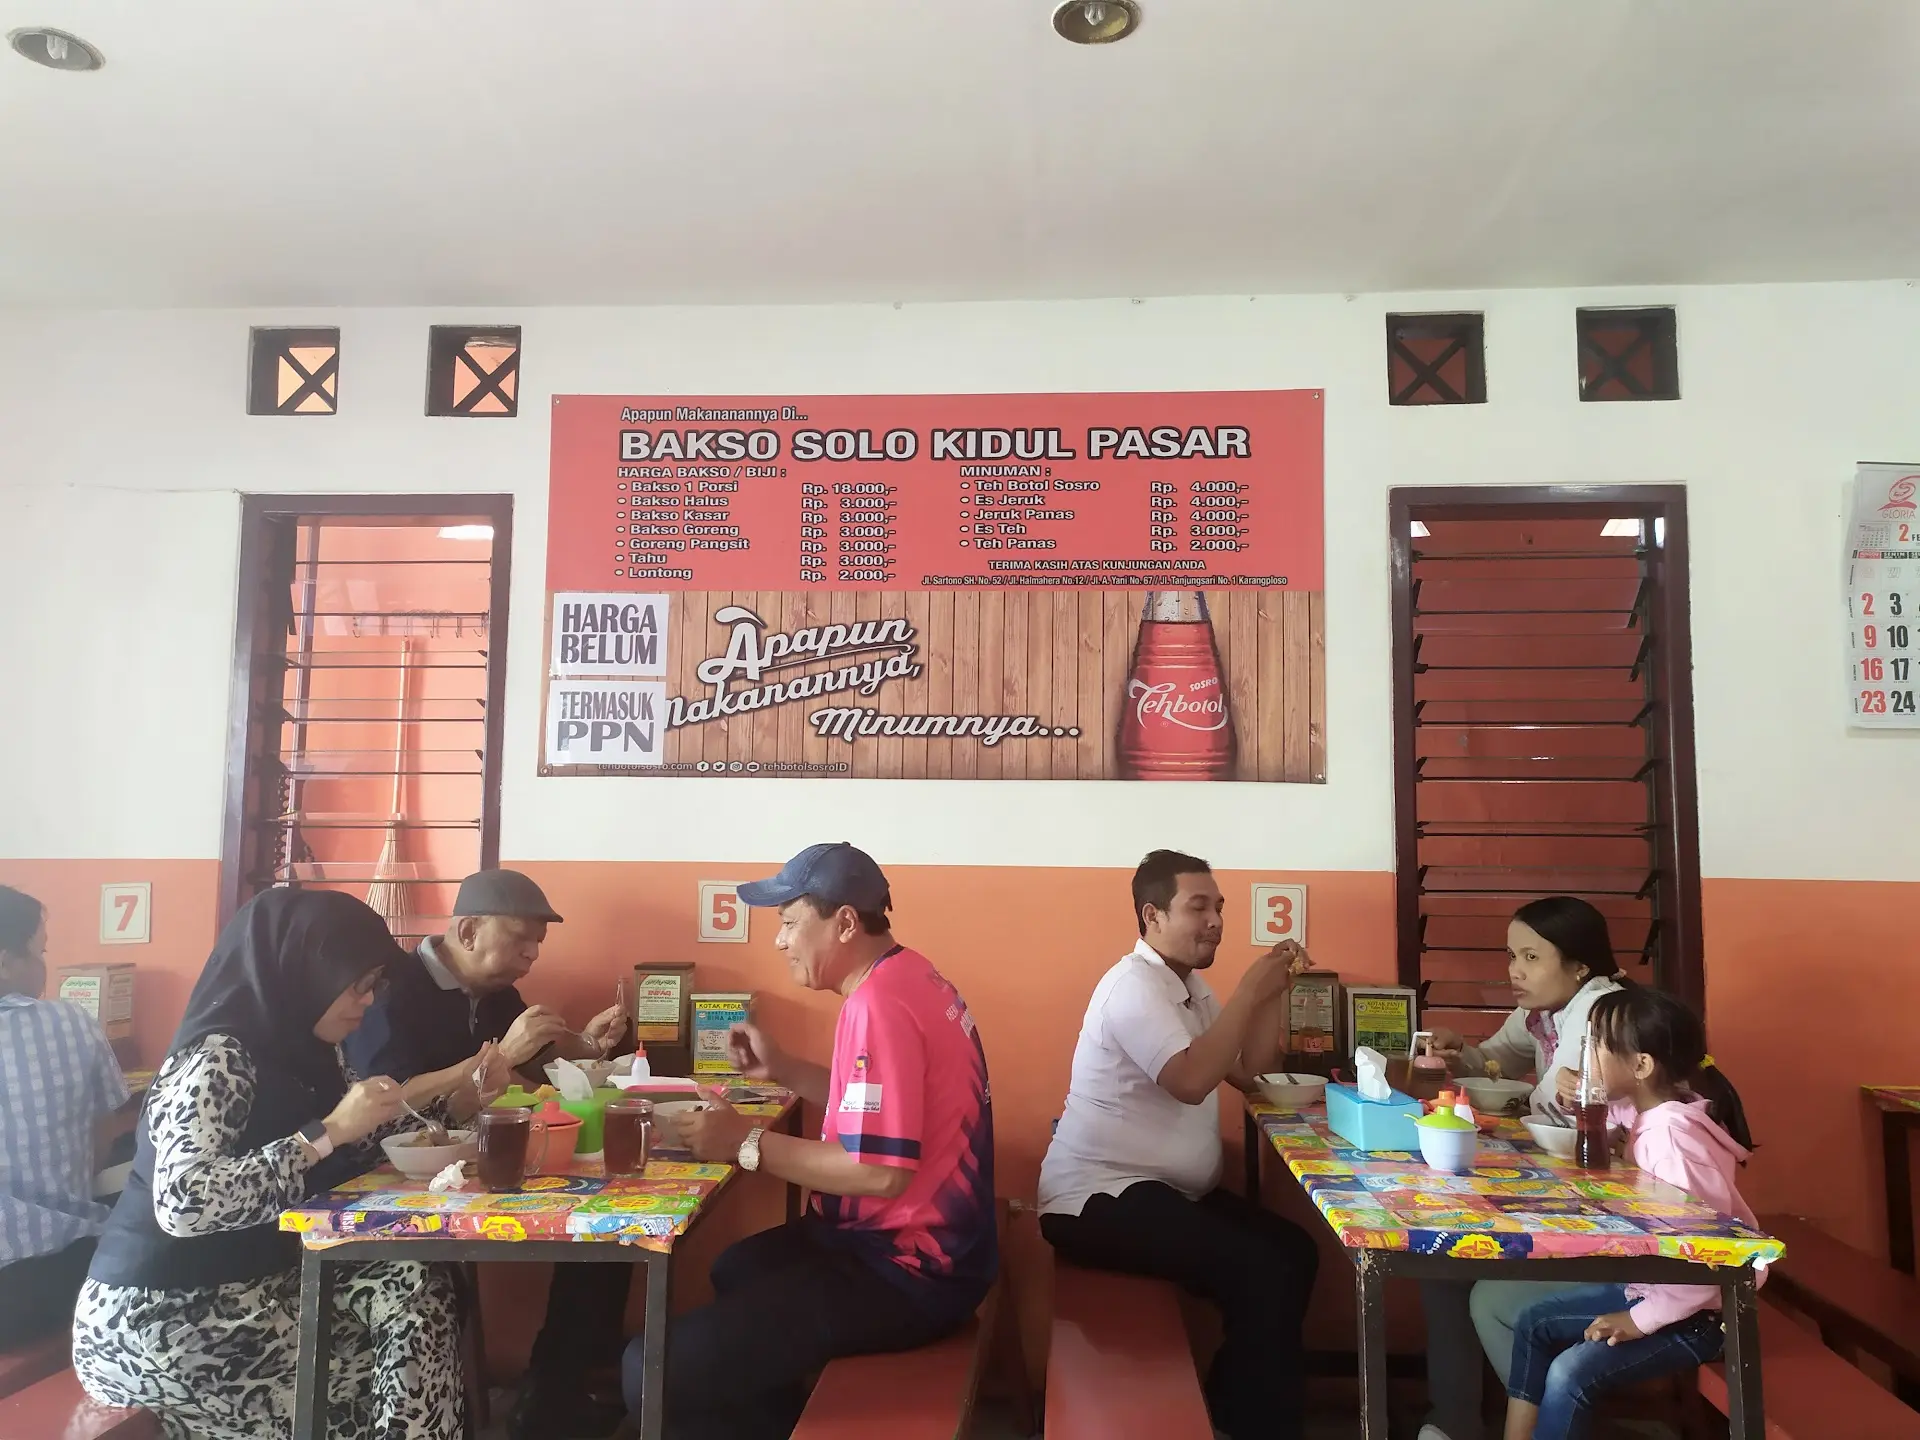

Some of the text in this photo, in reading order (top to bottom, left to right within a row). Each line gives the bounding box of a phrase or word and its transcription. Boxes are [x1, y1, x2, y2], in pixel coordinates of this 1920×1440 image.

[621, 406, 808, 422] Apapun Makananannya Di...
[619, 426, 1251, 462] BAKSO SOLO KIDUL PASAR
[618, 466, 672, 478] HARGA
[677, 466, 731, 478] BAKSO
[734, 466, 742, 478] /
[745, 466, 777, 478] BIJI
[960, 466, 1040, 477] MINUMAN
[631, 481, 897, 496] Bakso 1 Porsi Rp. 18.000,-
[975, 480, 1249, 494] Teh Botol Sosro Rp. 4.000,-
[631, 495, 897, 510] Bakso Halus Rp. 3.000,-
[975, 495, 1249, 509] Es Jeruk Rp. 4.000,-
[631, 510, 896, 524] Bakso Kasar Rp. 3.000,-
[974, 509, 1249, 523] Jeruk Panas Rp. 4.000,-
[1881, 509, 1916, 519] GLORIA
[630, 524, 896, 539] Bakso Goreng Rp. 3.000,-
[974, 523, 1249, 538] Es Teh Rp. 3.000,-
[1898, 523, 1910, 542] 2
[630, 538, 896, 553] Goreng Pangsit Rp. 3.000,-
[974, 538, 1249, 553] Teh Panas Rp. 2.000,-
[630, 553, 896, 568] Tahu Rp. 3.000,-
[989, 560, 1206, 570] TERIMA KASIH ATAS KUNJUNGAN ANDA
[629, 567, 896, 582] Lontong Rp. 2.000,-
[933, 575, 961, 585] Sartono
[992, 575, 1002, 585] 52
[1019, 575, 1060, 585] Halmahera
[1111, 575, 1127, 585] Yani
[1171, 575, 1216, 587] Tanjungsari
[1232, 575, 1236, 585] 1
[1238, 575, 1288, 587] Karangploso
[1861, 592, 1875, 615] 2
[1889, 592, 1902, 616] 3
[561, 603, 658, 633] HARGA
[1864, 625, 1876, 648] 9
[1887, 625, 1909, 648] 10
[560, 634, 658, 665] BELUM
[698, 618, 914, 684] Apapun
[1861, 658, 1883, 680] 16
[1890, 658, 1909, 680] 17
[1189, 677, 1218, 692] SOSRO
[559, 691, 654, 720] TERMASUK
[1861, 691, 1886, 713] 23
[1891, 691, 1916, 713] 24
[810, 707, 1082, 746] Minumnya...
[557, 721, 653, 752] PPN
[114, 894, 138, 932] 7
[712, 893, 737, 931] 5
[1265, 895, 1293, 935] 3
